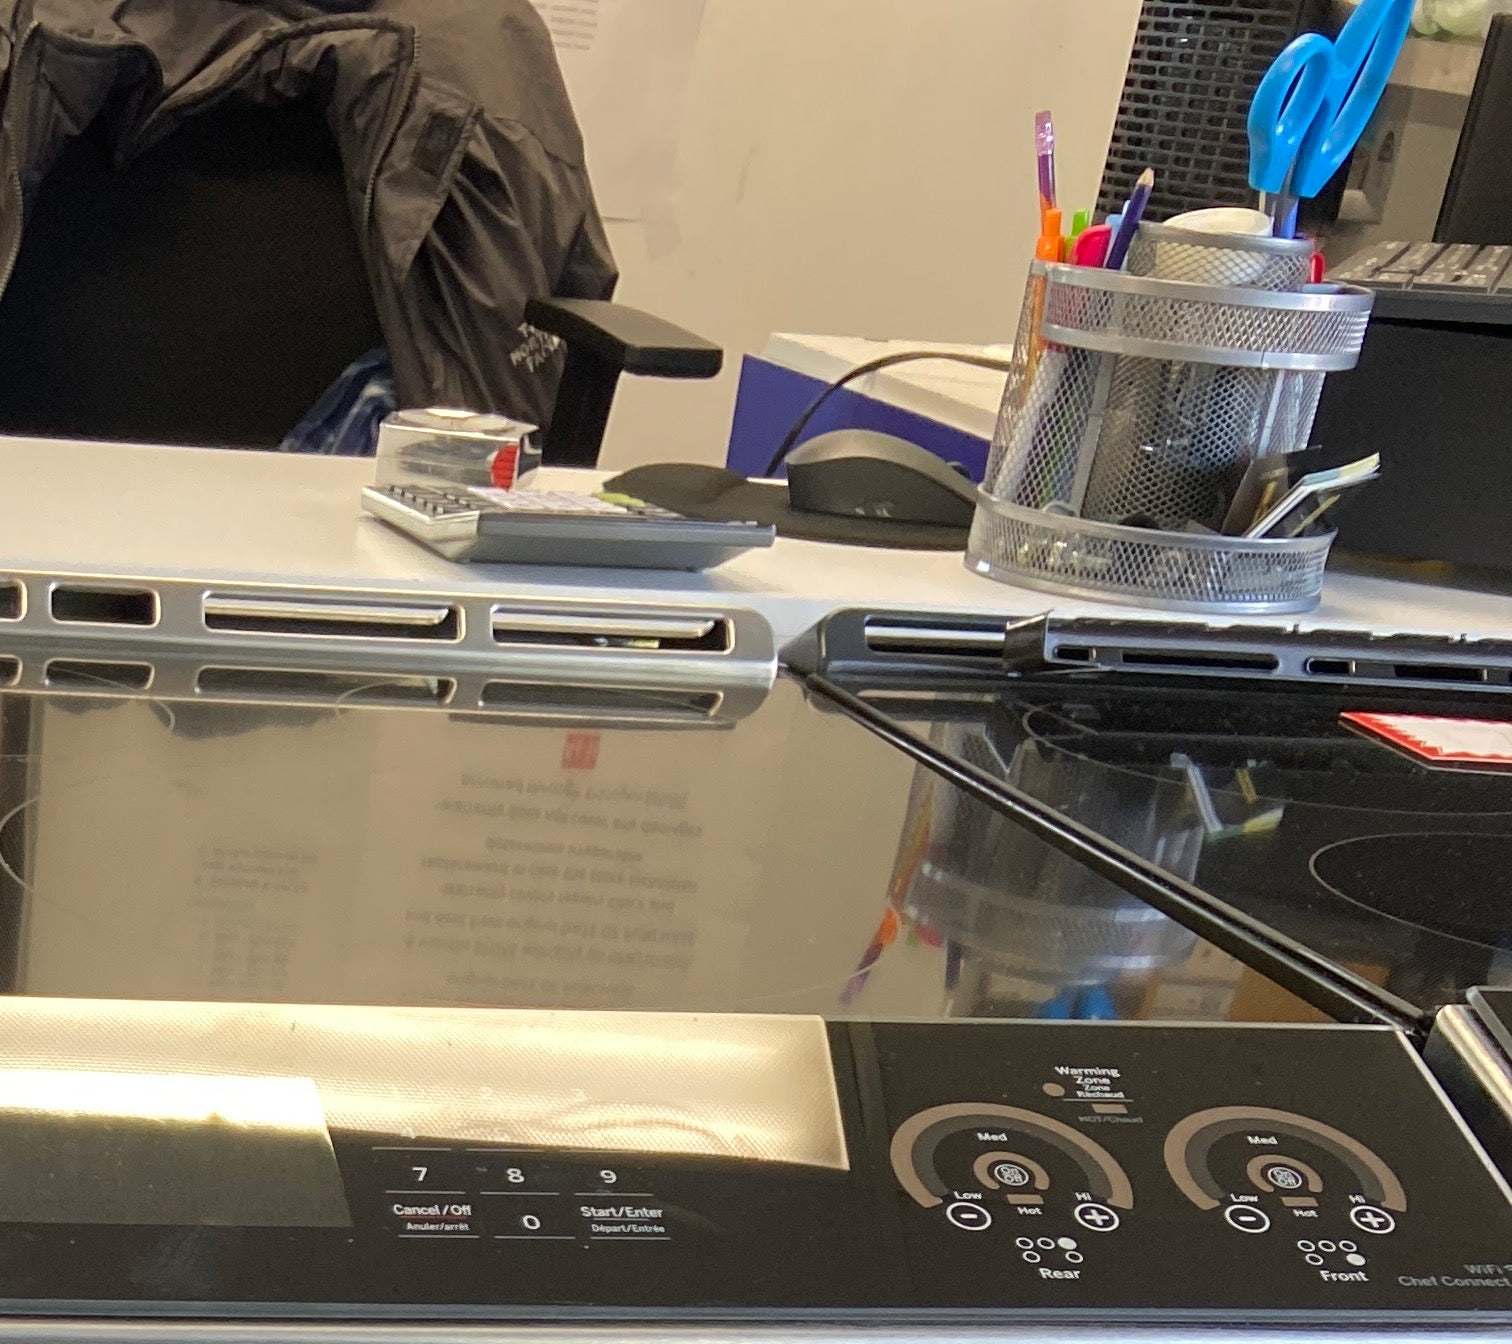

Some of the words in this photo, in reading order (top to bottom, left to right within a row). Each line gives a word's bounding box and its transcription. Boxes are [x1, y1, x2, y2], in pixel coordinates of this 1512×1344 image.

[1054, 1066, 1120, 1078] Warming
[1074, 1075, 1111, 1084] Zone
[977, 1132, 1008, 1142] Med
[1246, 1135, 1278, 1146] Med
[412, 1167, 428, 1182] 7
[506, 1168, 525, 1184] 8
[600, 1169, 617, 1184] 9
[953, 1191, 982, 1201] Low
[1074, 1191, 1092, 1202] Hi
[1230, 1193, 1258, 1203] Low
[1349, 1194, 1366, 1204] Hi
[1017, 1206, 1043, 1216] Hot
[1293, 1209, 1319, 1219] Hot
[522, 1214, 542, 1231] 0
[1038, 1267, 1081, 1280] Rear
[1319, 1270, 1369, 1283] Front
[1398, 1275, 1438, 1287] Chef
